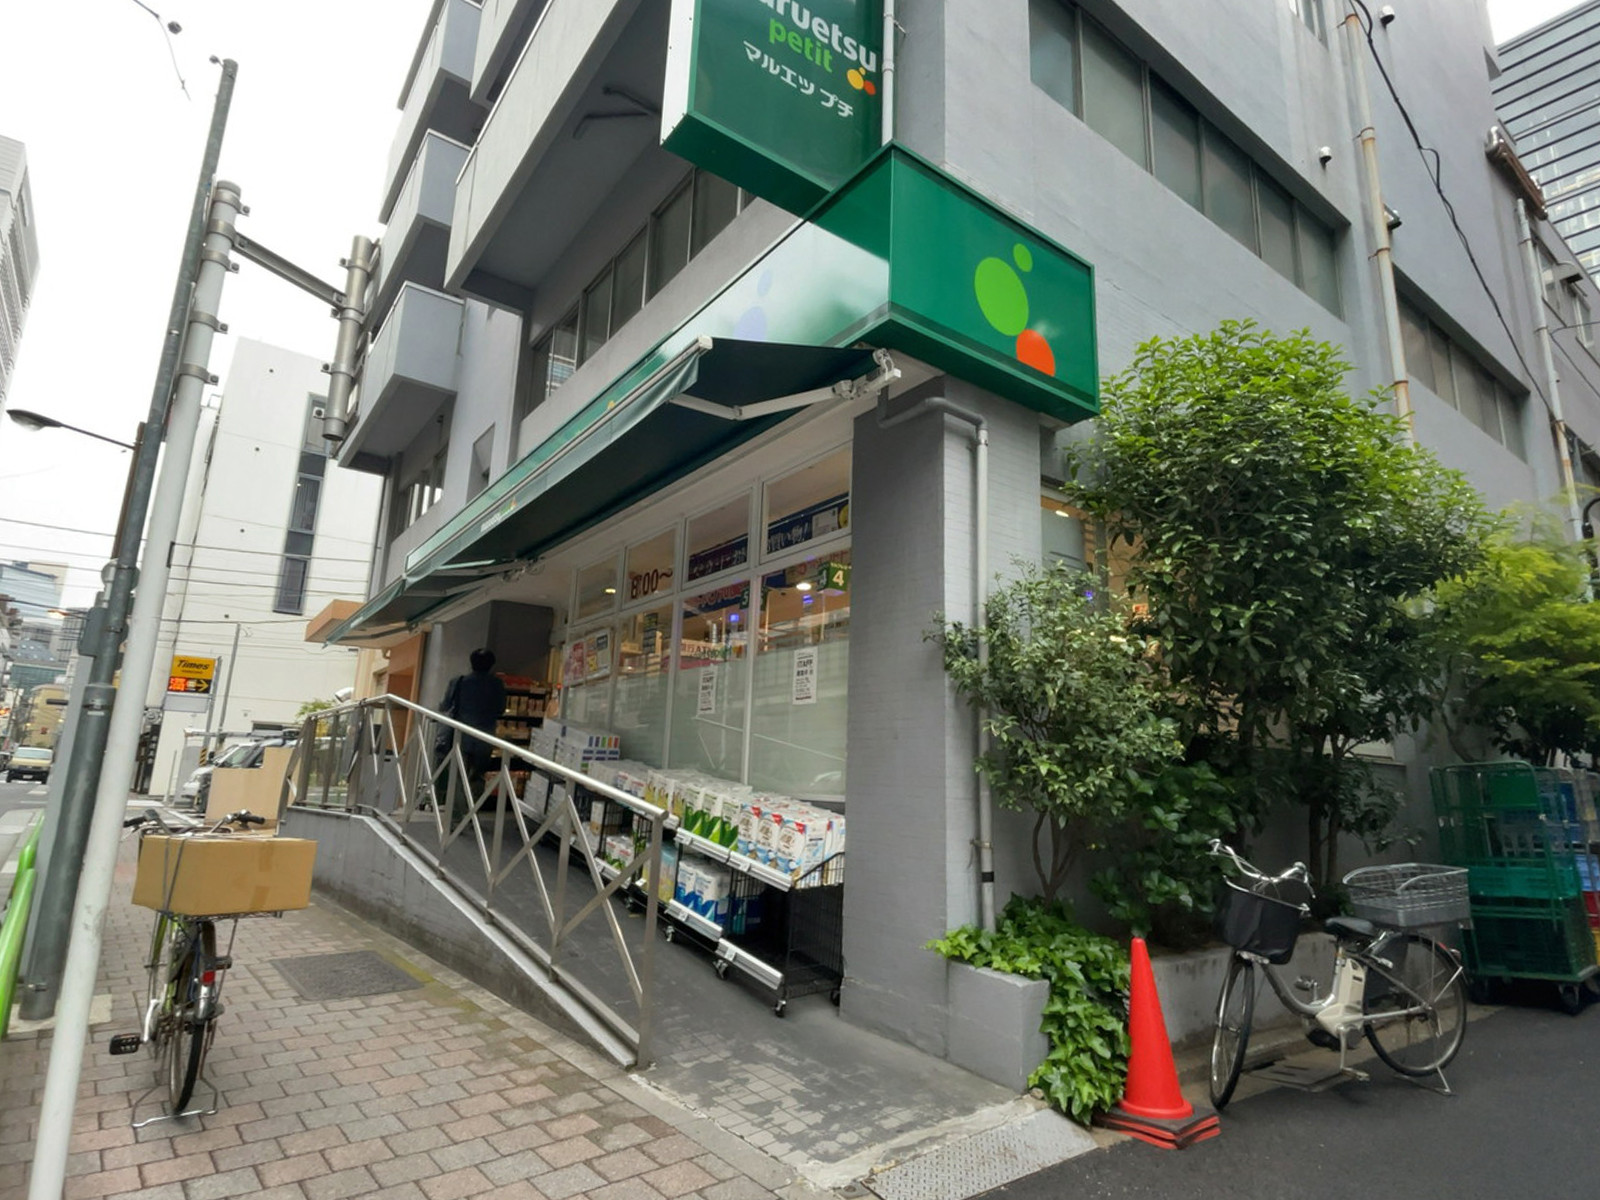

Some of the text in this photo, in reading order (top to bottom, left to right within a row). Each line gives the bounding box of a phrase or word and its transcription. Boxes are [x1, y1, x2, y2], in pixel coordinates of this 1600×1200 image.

[769, 17, 832, 73] petit
[743, 40, 853, 117] マルエツ プチ
[832, 570, 844, 586] 4
[177, 659, 210, 670] Times
